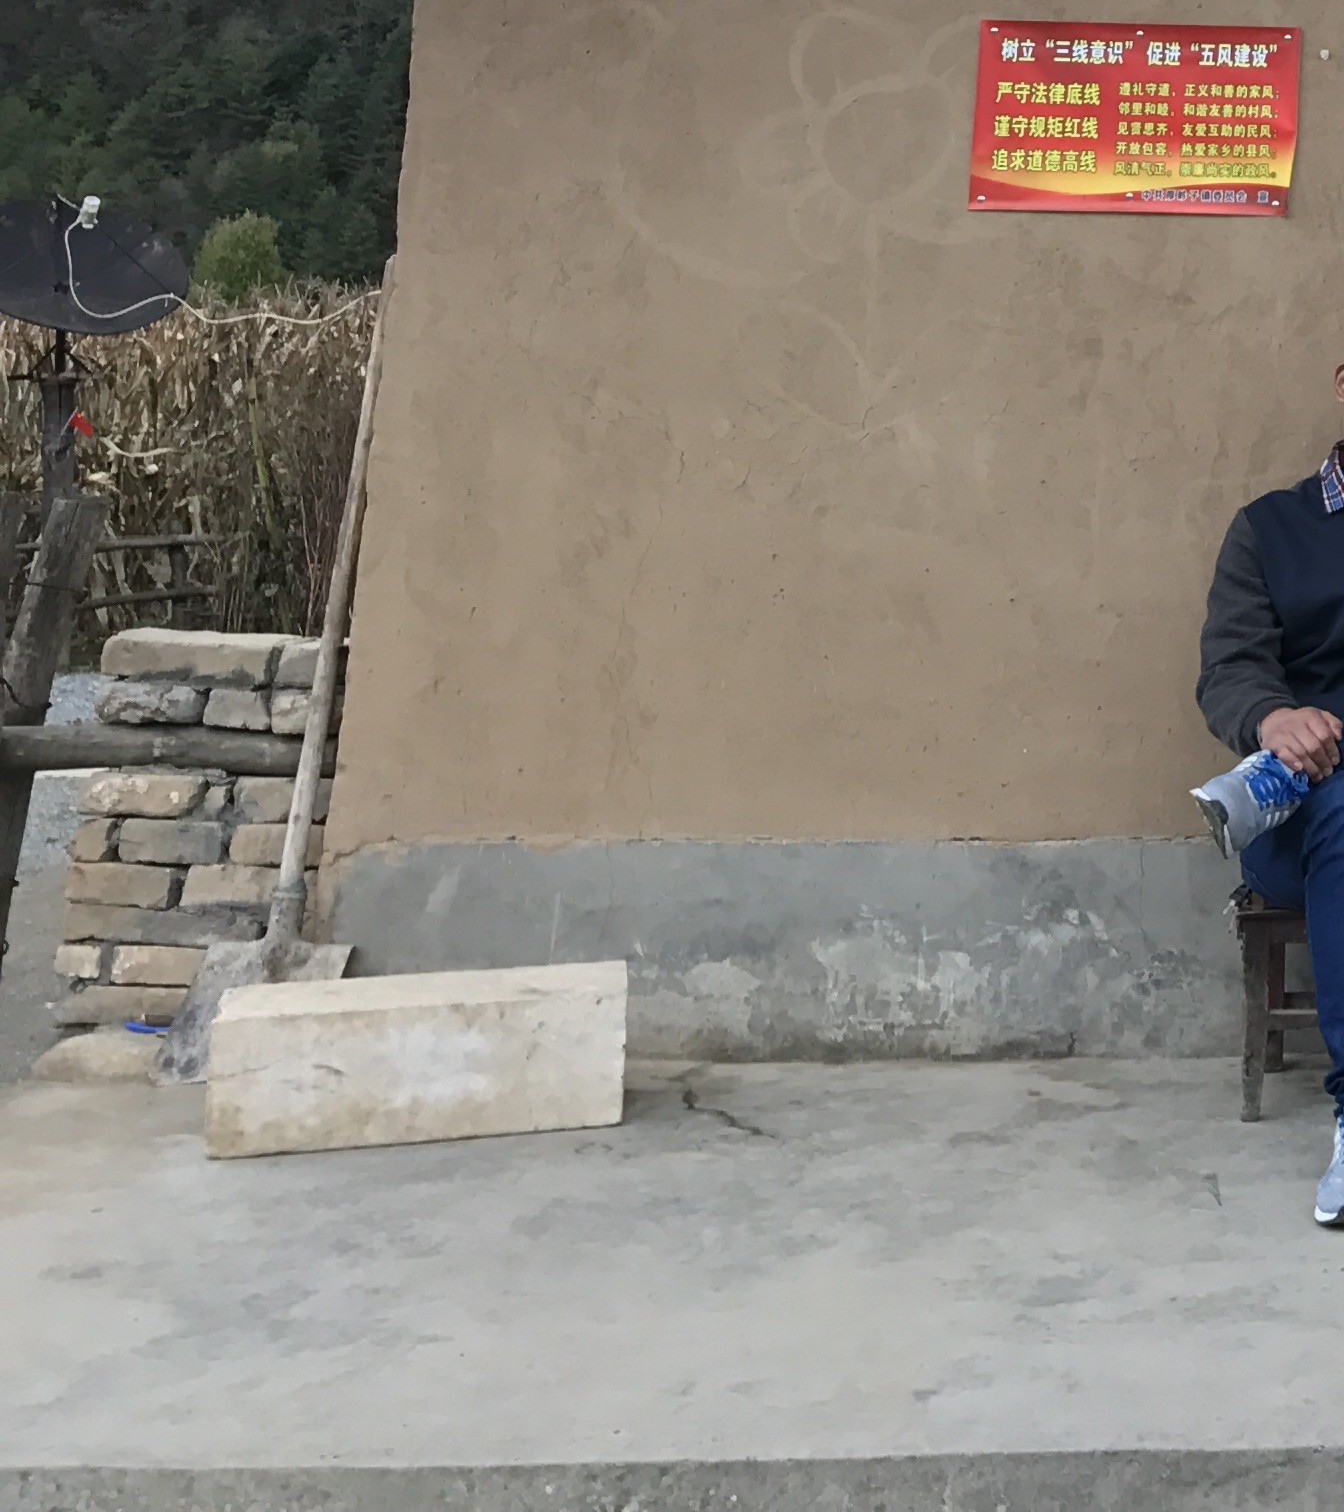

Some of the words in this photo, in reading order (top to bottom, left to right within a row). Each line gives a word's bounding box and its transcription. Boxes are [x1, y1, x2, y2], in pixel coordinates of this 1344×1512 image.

[995, 81, 1101, 106] 严守法律底线
[993, 115, 1099, 140] 谨守规矩红线
[991, 149, 1097, 173] 追求道德高线
